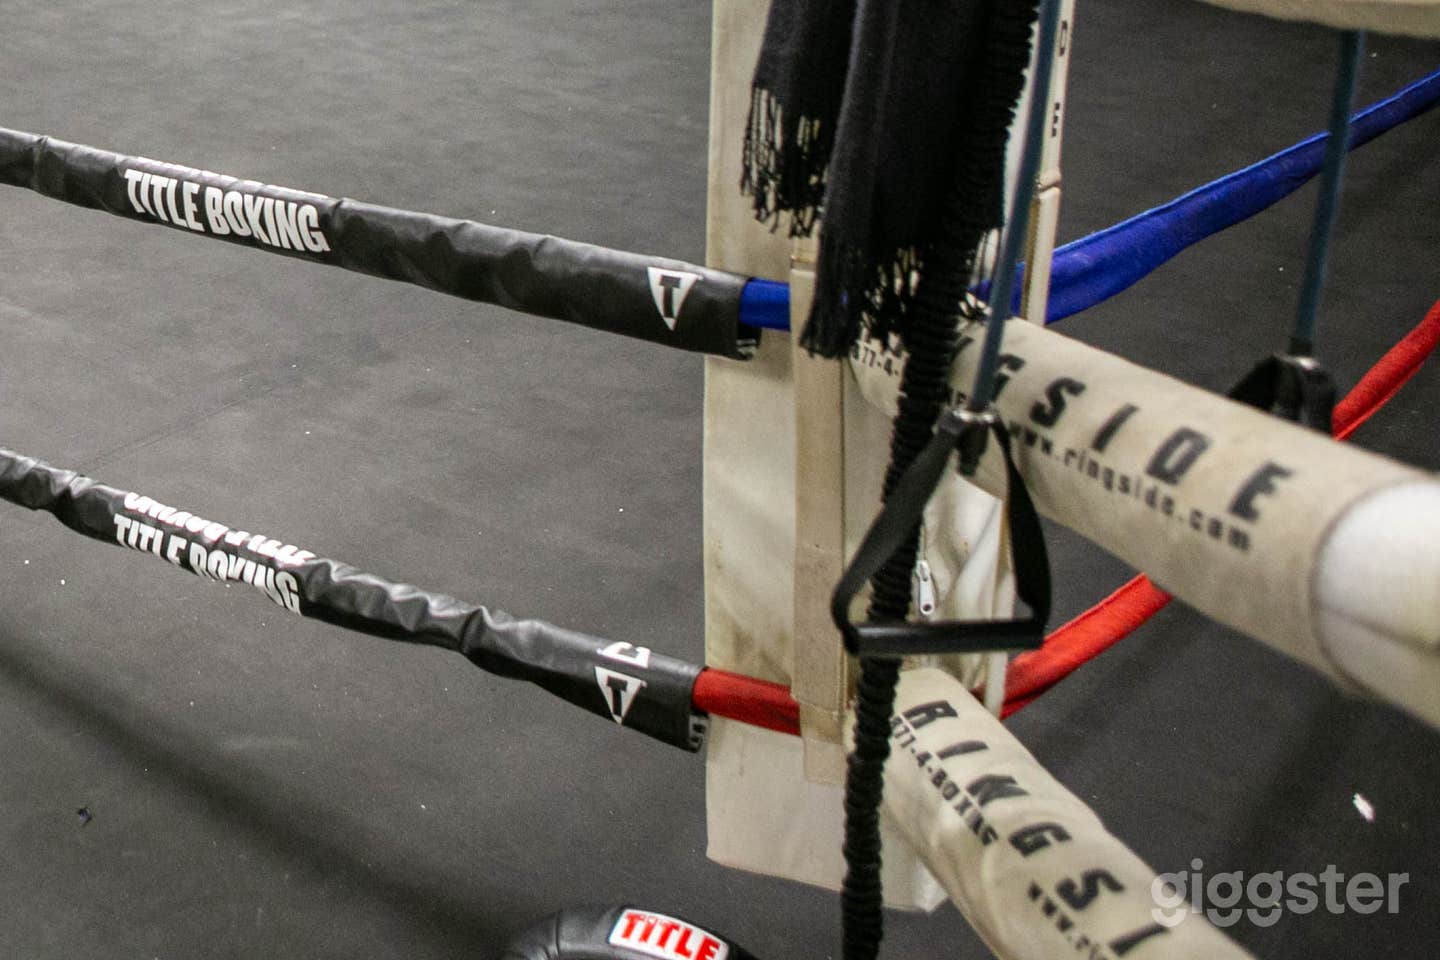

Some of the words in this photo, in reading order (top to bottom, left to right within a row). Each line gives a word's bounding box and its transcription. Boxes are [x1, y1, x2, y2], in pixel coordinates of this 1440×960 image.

[124, 169, 205, 233] TITLE
[204, 185, 331, 253] BOXING
[620, 911, 722, 960] TITLE
